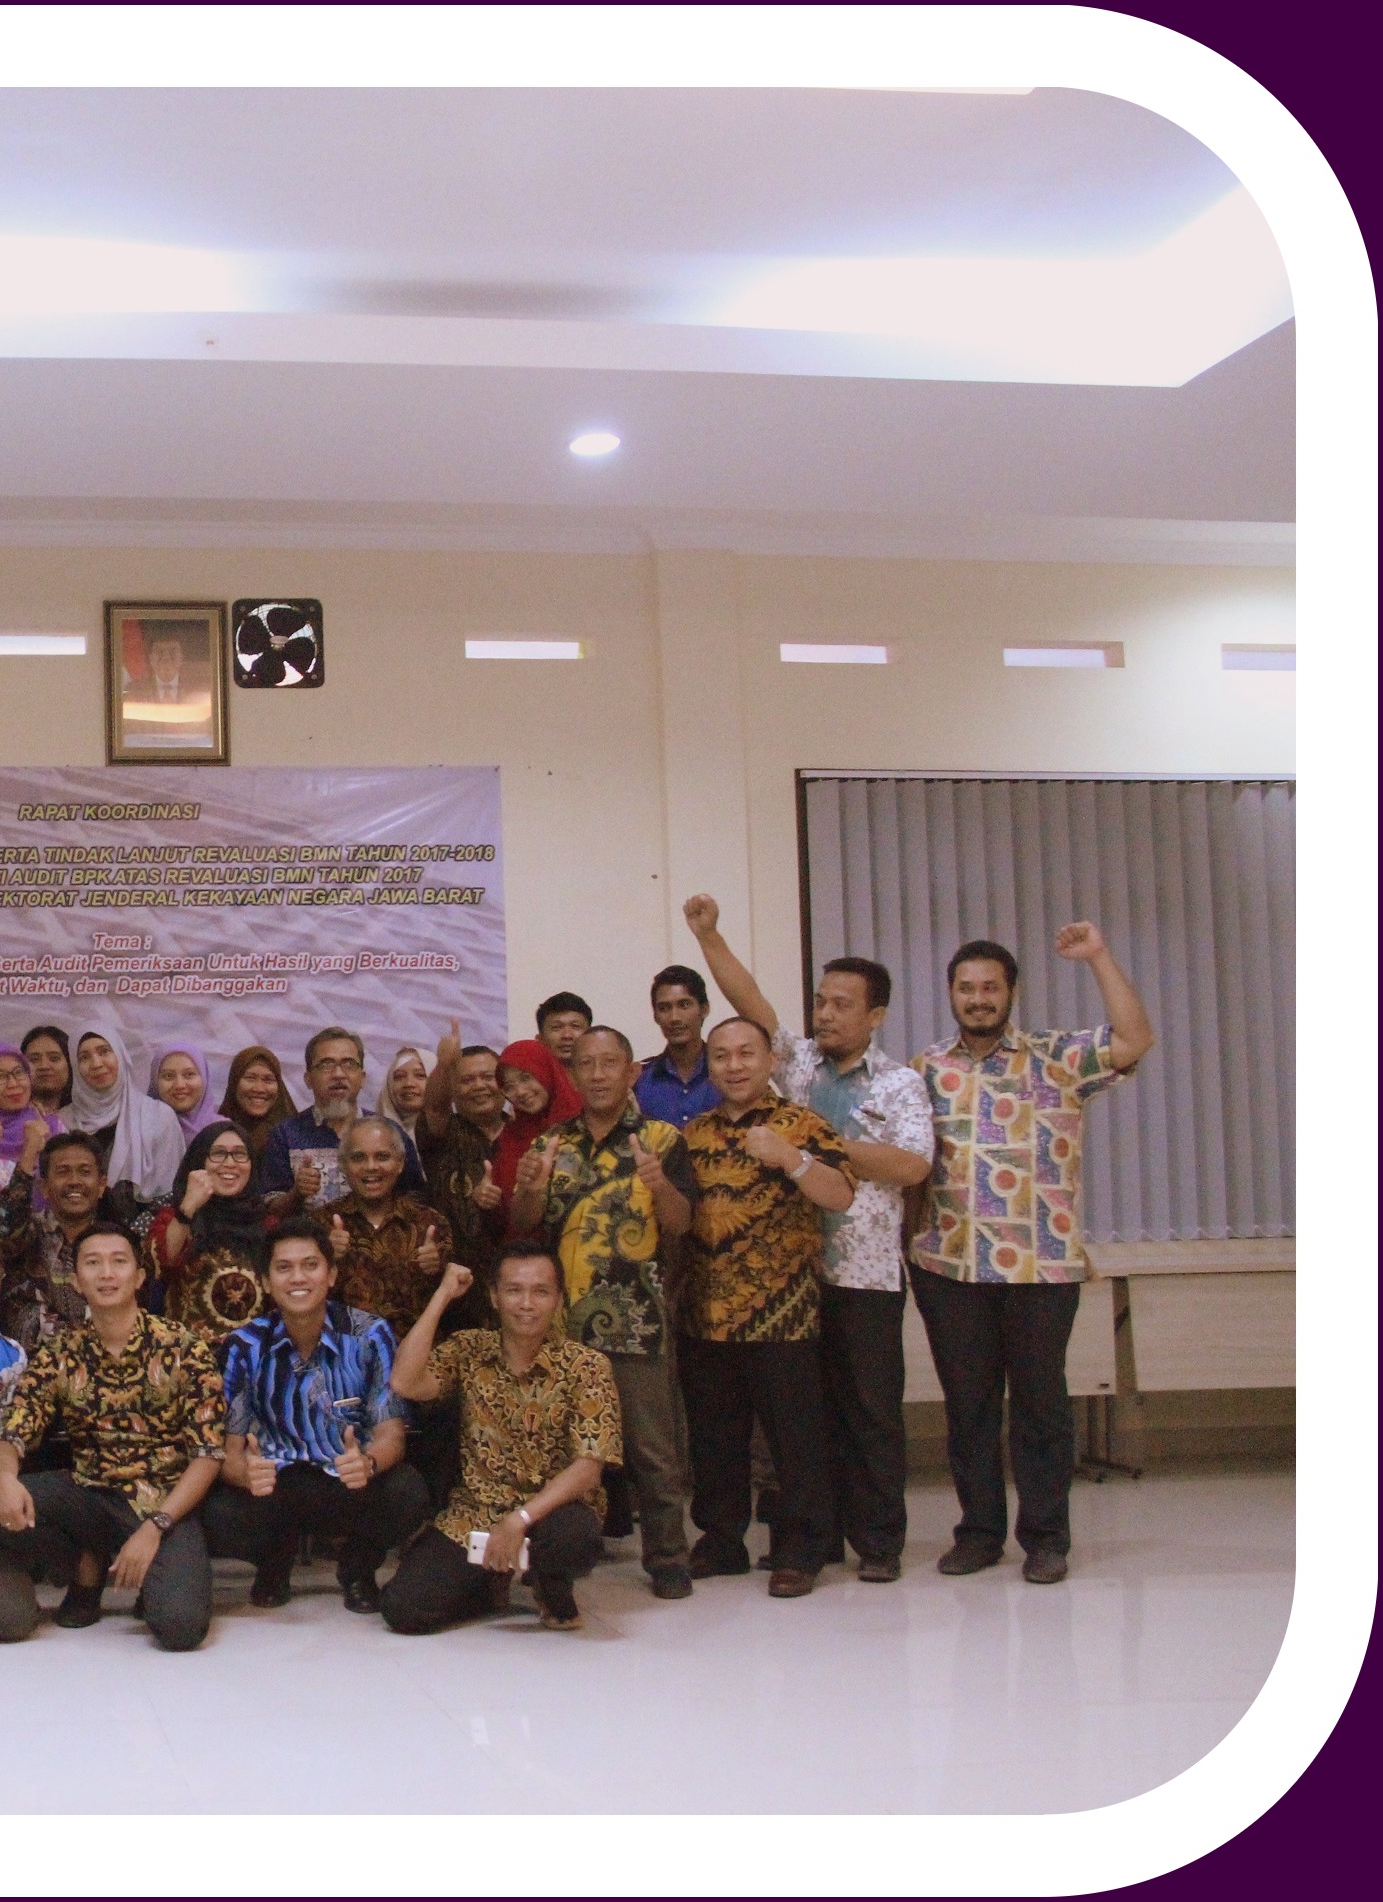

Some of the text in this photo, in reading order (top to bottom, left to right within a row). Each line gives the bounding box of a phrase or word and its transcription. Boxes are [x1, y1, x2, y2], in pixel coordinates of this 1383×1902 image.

[18, 803, 201, 821] RAPAT KOORDINASI
[45, 846, 114, 864] TINDAK
[116, 846, 191, 864] LANJUT
[193, 846, 297, 863] REVALUASI
[299, 845, 342, 863] BMN
[346, 845, 407, 862] TAHUN
[411, 844, 496, 862] 2017-2018
[10, 868, 68, 886] AUDIT
[70, 868, 112, 886] BPK
[113, 868, 162, 886] ATAS
[164, 867, 269, 885] REVALUASI
[271, 867, 314, 885] BMN
[319, 867, 380, 884] TAHUN
[383, 866, 424, 883] 2017
[80, 889, 179, 907] JENDERAL
[183, 889, 284, 906] KEKAYAAN
[286, 888, 365, 906] NEGARA
[368, 888, 421, 905] JAWA
[422, 888, 485, 905] BARAT
[94, 933, 141, 949] Tema
[38, 954, 89, 973] Audit
[91, 954, 203, 973] Pemeriksaan
[208, 953, 264, 972] Untuk
[265, 952, 309, 971] Hasil
[310, 954, 354, 974] yang
[357, 951, 460, 971] Berkualitas,
[9, 977, 71, 996] Waktu,
[74, 977, 109, 995] dan
[116, 976, 171, 996] Dapat
[172, 974, 287, 996] Dibanggakan
